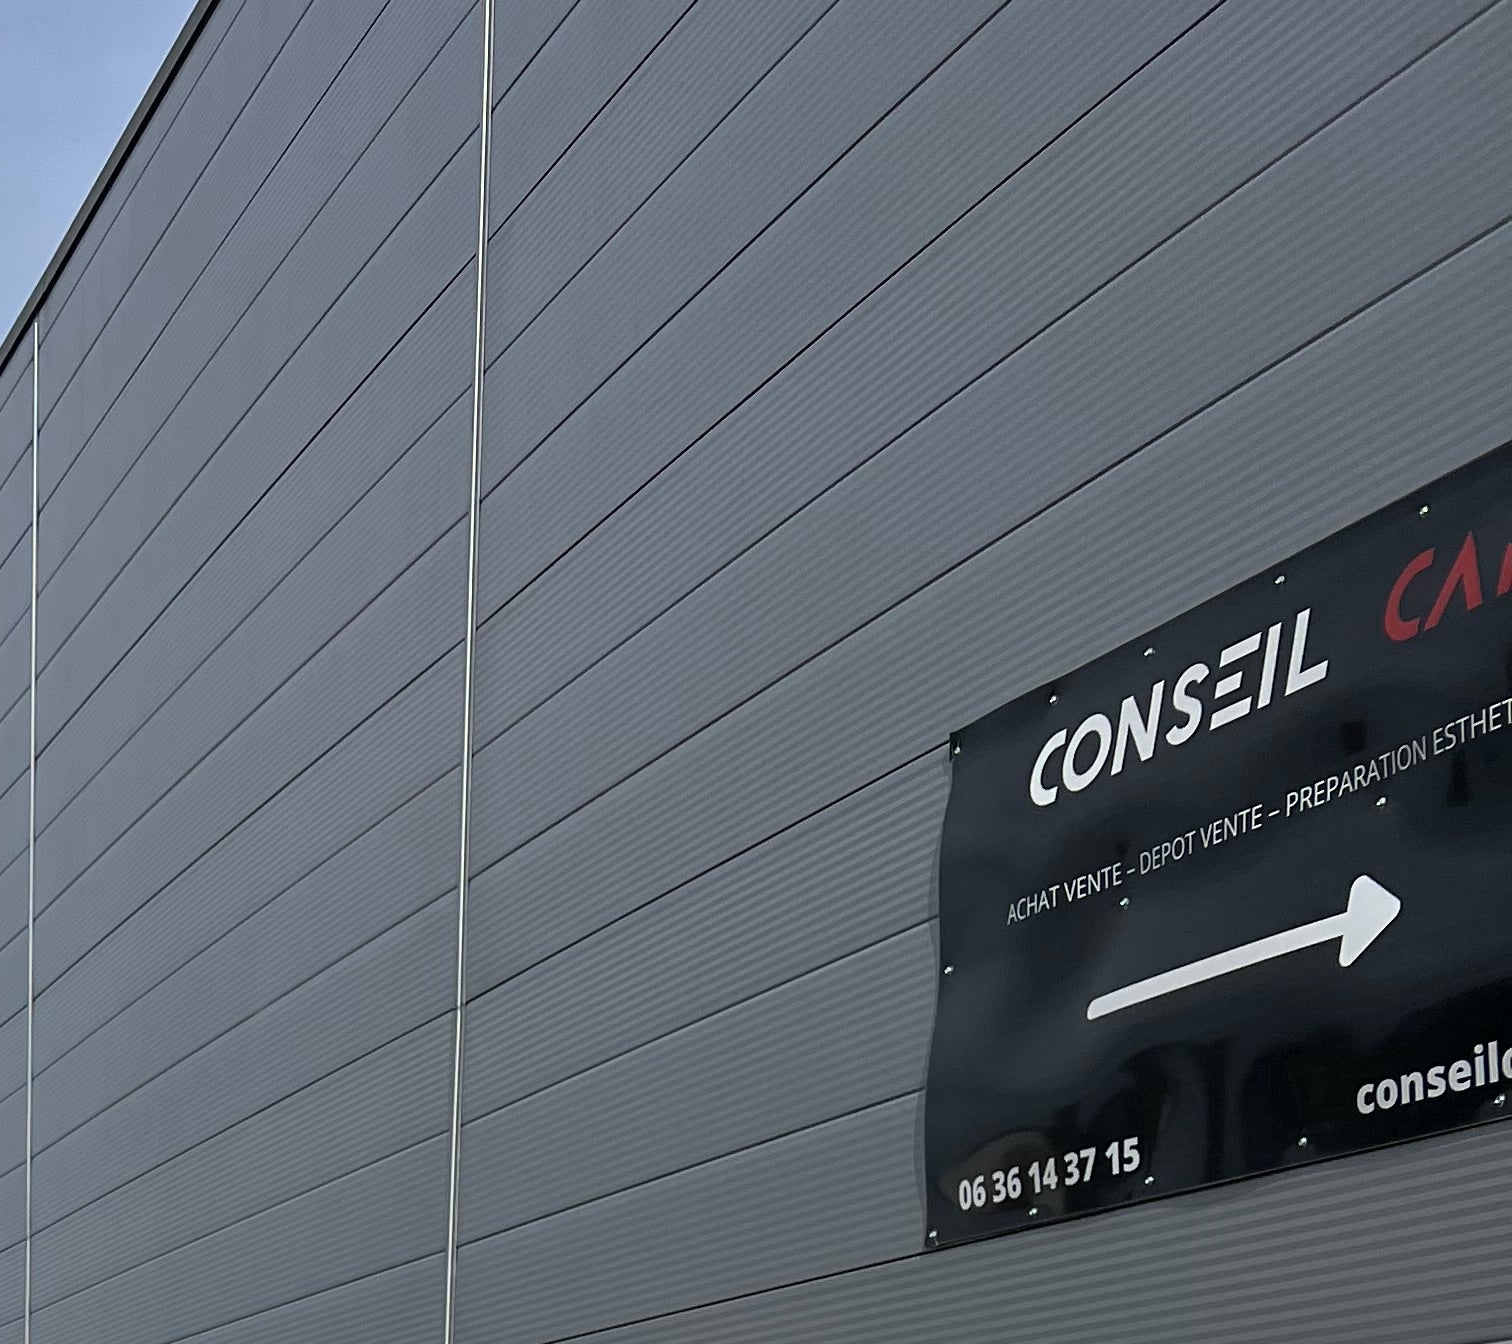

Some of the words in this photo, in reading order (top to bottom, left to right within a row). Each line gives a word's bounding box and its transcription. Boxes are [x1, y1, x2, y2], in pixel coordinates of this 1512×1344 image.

[1029, 608, 1329, 806] CONSEIL
[1006, 885, 1060, 926] ACHAT
[1064, 862, 1122, 902] VENTE
[1139, 830, 1196, 875] DEPOT
[1200, 804, 1263, 849] VENTE
[1286, 735, 1427, 818] PREPARATION
[958, 1175, 987, 1211] 06
[992, 1166, 1022, 1203] 36
[1028, 1157, 1058, 1194] 14
[1064, 1147, 1096, 1186] 37
[1105, 1136, 1140, 1175] 15
